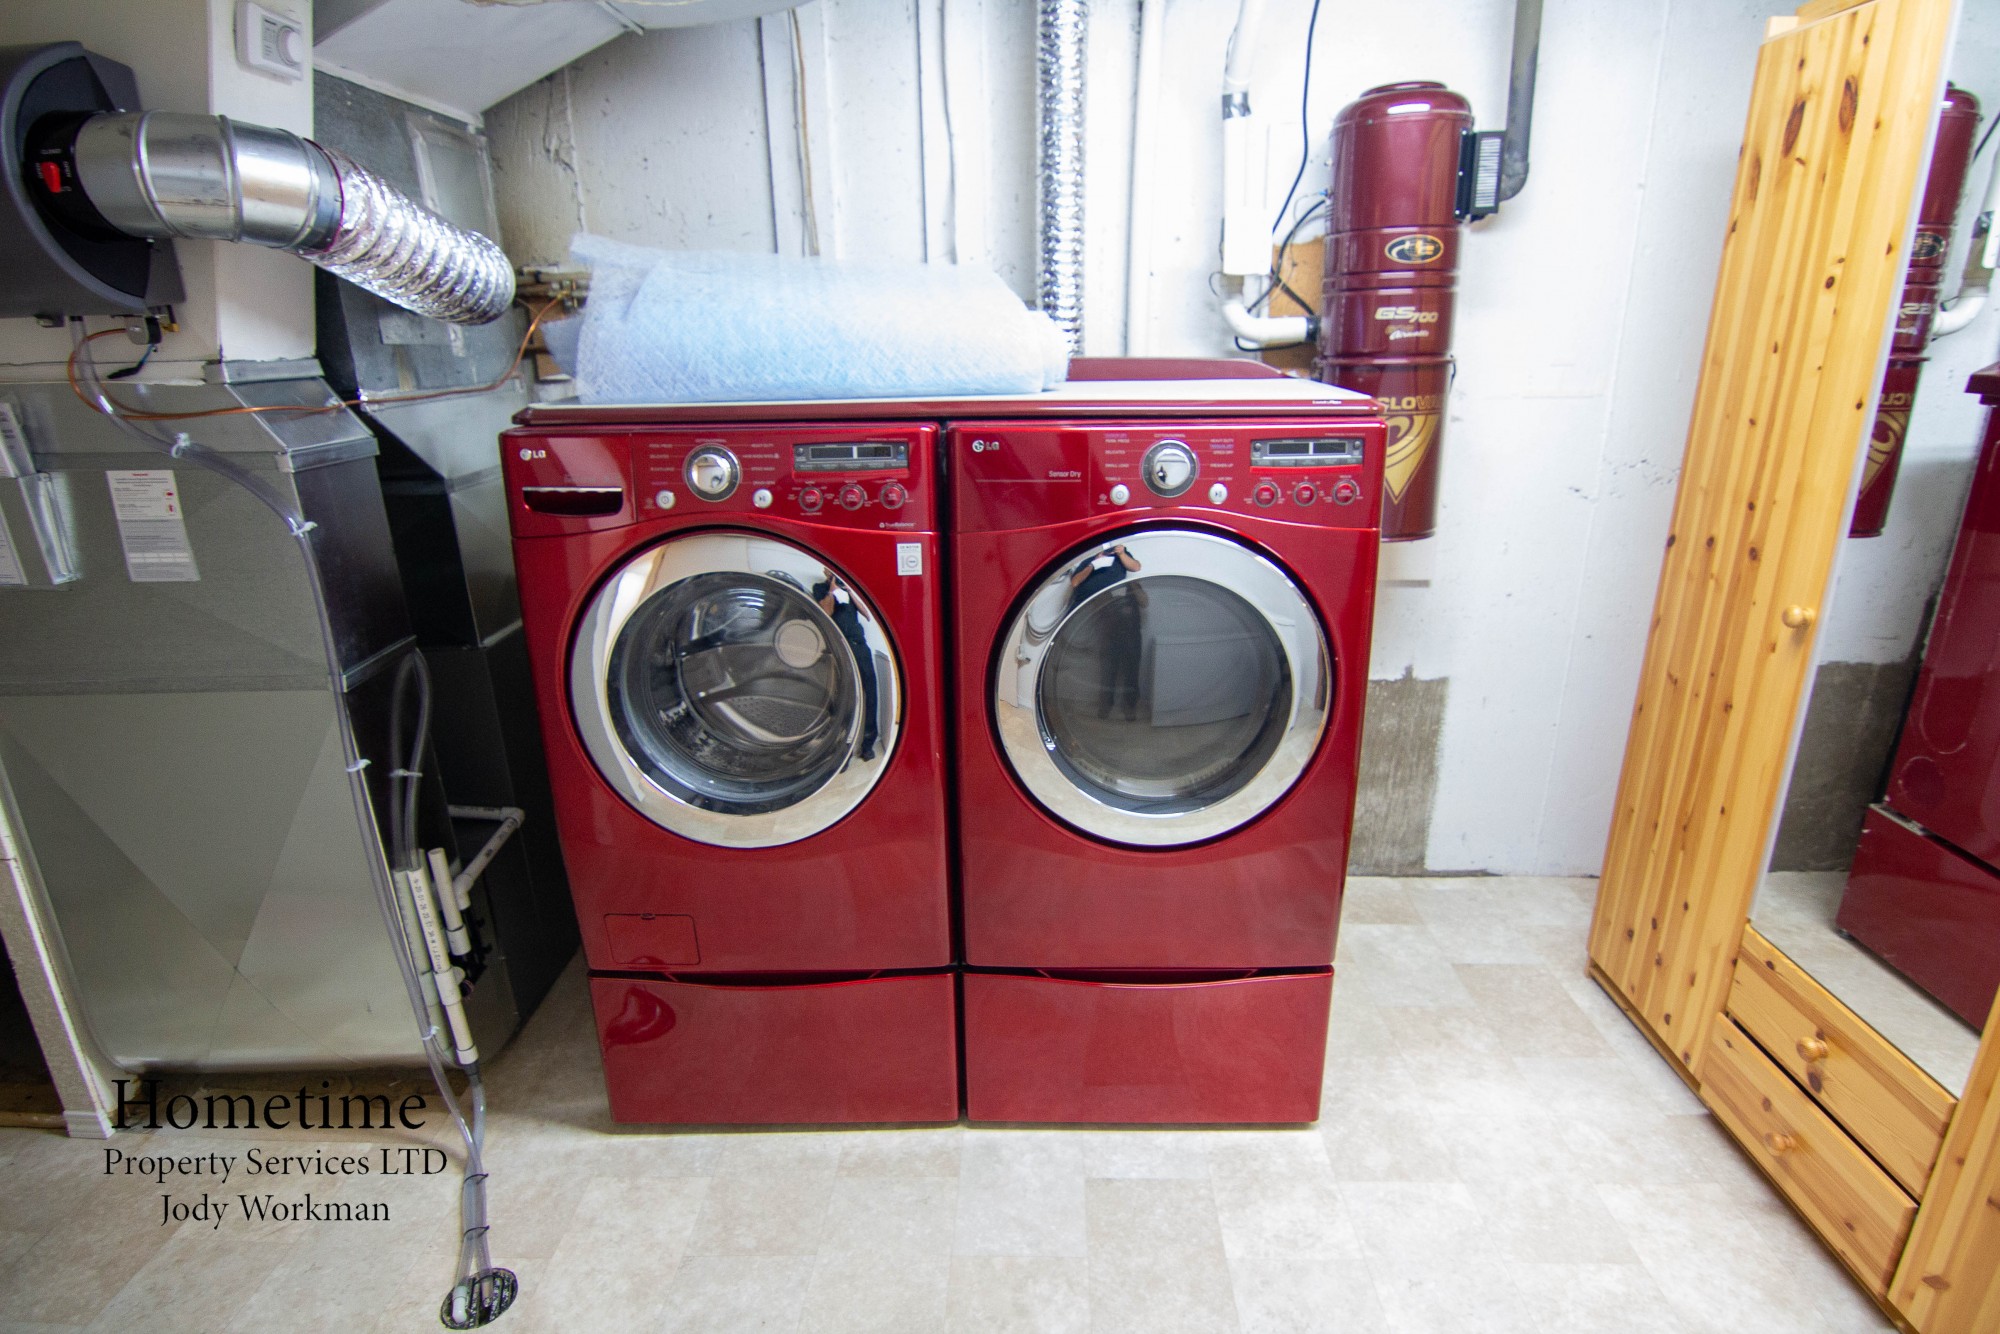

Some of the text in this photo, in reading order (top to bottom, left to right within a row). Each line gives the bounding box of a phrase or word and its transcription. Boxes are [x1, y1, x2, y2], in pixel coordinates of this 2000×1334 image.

[985, 441, 1000, 451] LG
[532, 450, 547, 459] LG
[1048, 470, 1082, 479] Sensor Dry
